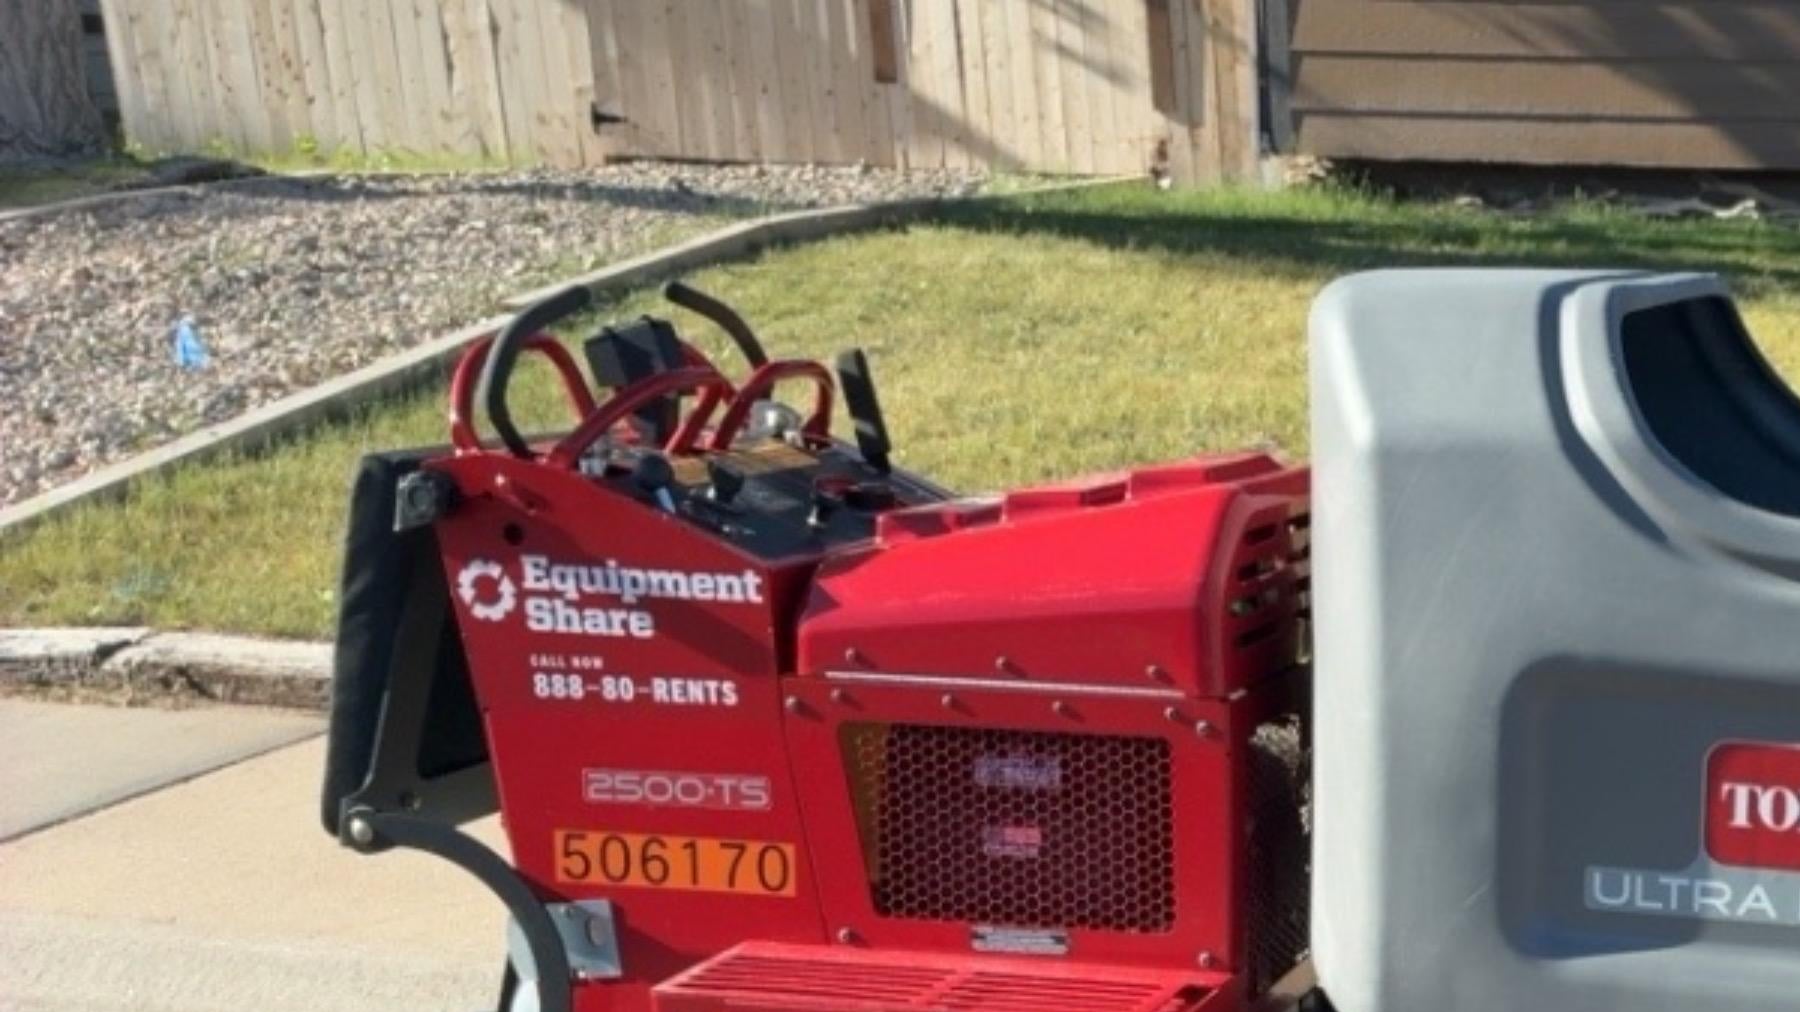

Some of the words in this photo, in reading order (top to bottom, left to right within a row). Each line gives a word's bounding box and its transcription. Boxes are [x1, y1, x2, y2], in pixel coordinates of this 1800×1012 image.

[521, 555, 764, 604] Equipment
[526, 598, 656, 638] Share
[530, 653, 567, 668] CALL
[571, 656, 605, 670] NOW
[533, 673, 739, 706] 888-80-RENTS
[561, 832, 791, 893] 506170
[1591, 871, 1778, 918] ULTRA
